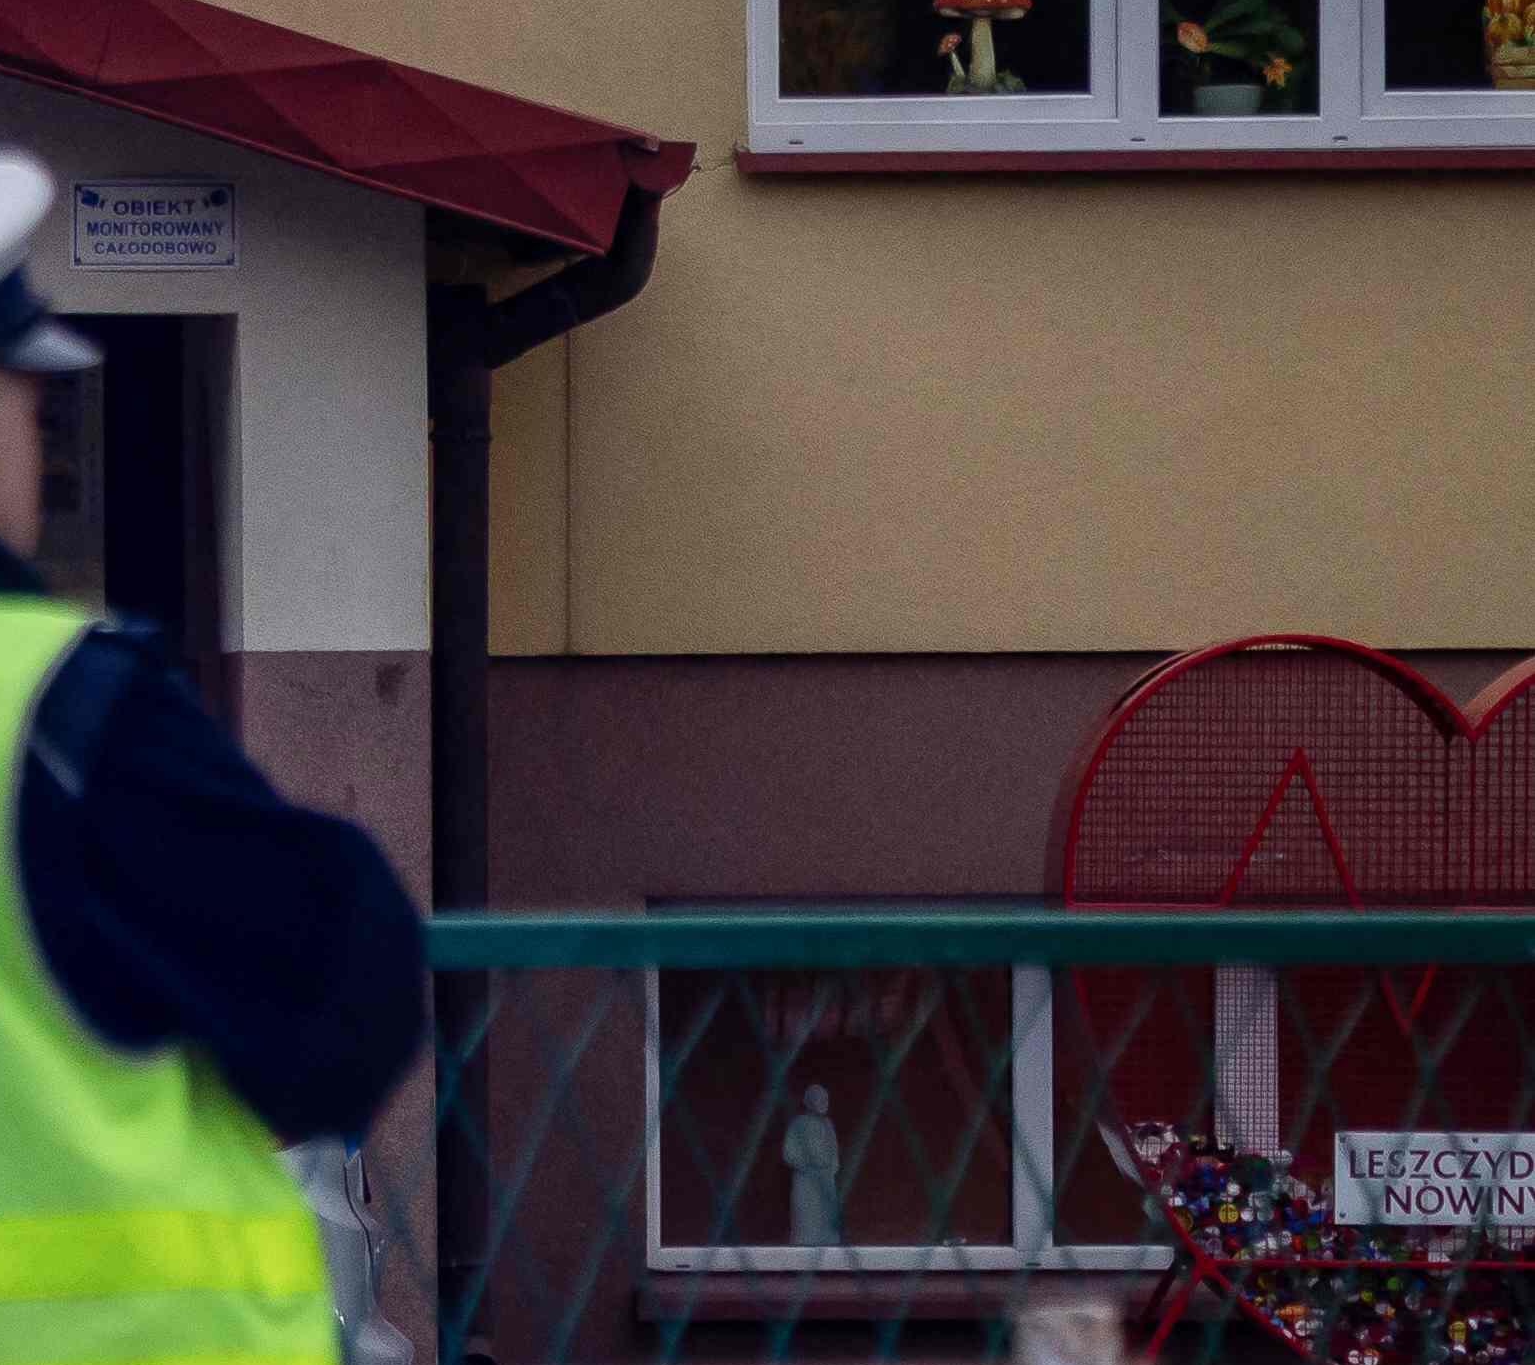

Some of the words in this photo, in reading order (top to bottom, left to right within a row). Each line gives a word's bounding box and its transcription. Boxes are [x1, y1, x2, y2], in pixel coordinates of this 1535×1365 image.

[113, 200, 195, 216] OBIEKT
[86, 221, 223, 236] MONITOROWANY
[94, 241, 217, 255] CAŁODOBOWO
